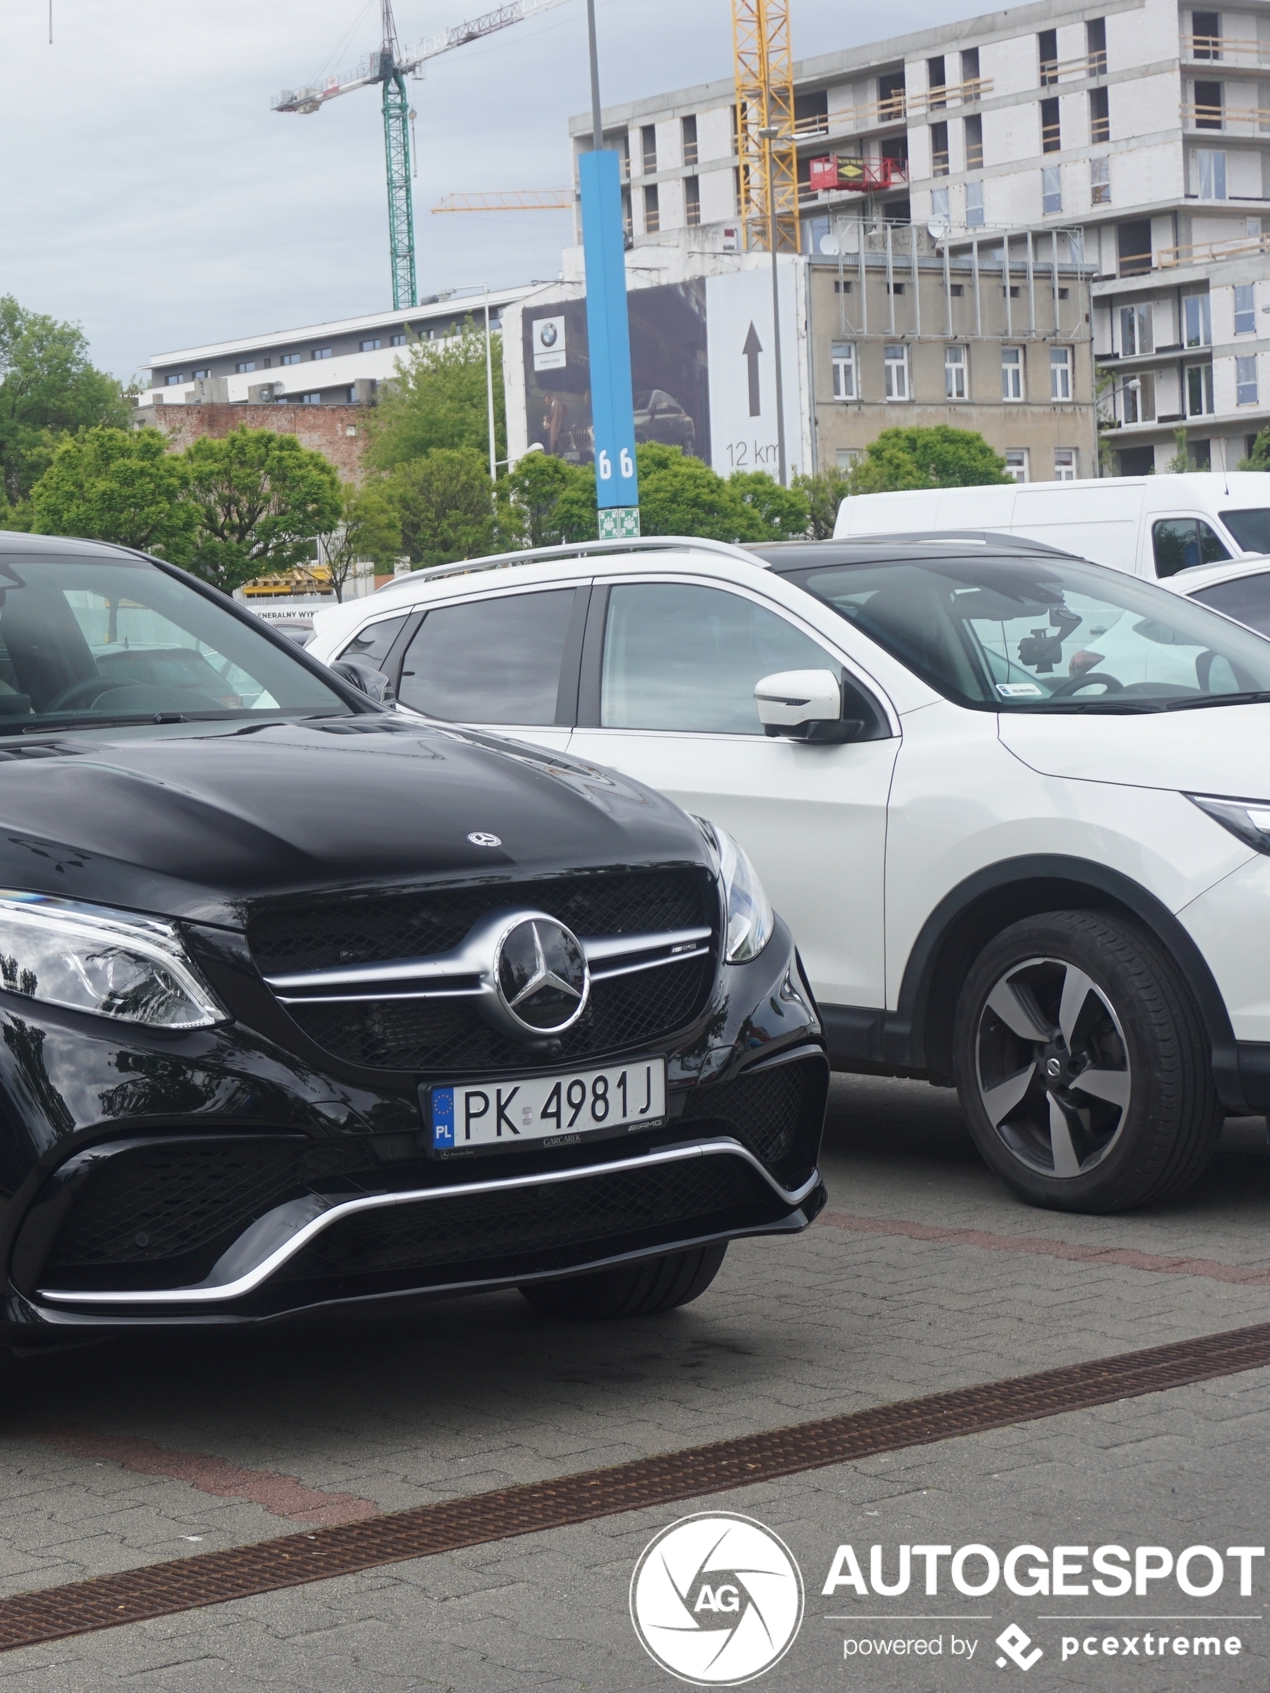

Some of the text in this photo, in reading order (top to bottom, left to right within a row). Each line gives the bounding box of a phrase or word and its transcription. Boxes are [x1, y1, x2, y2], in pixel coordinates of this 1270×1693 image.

[599, 449, 612, 480] 6
[620, 447, 634, 478] 6
[726, 441, 748, 467] 12
[256, 611, 297, 619] ENERALNY
[464, 1066, 652, 1140] PK 4981J
[435, 1125, 452, 1139] PL
[638, 1119, 663, 1129] AMG
